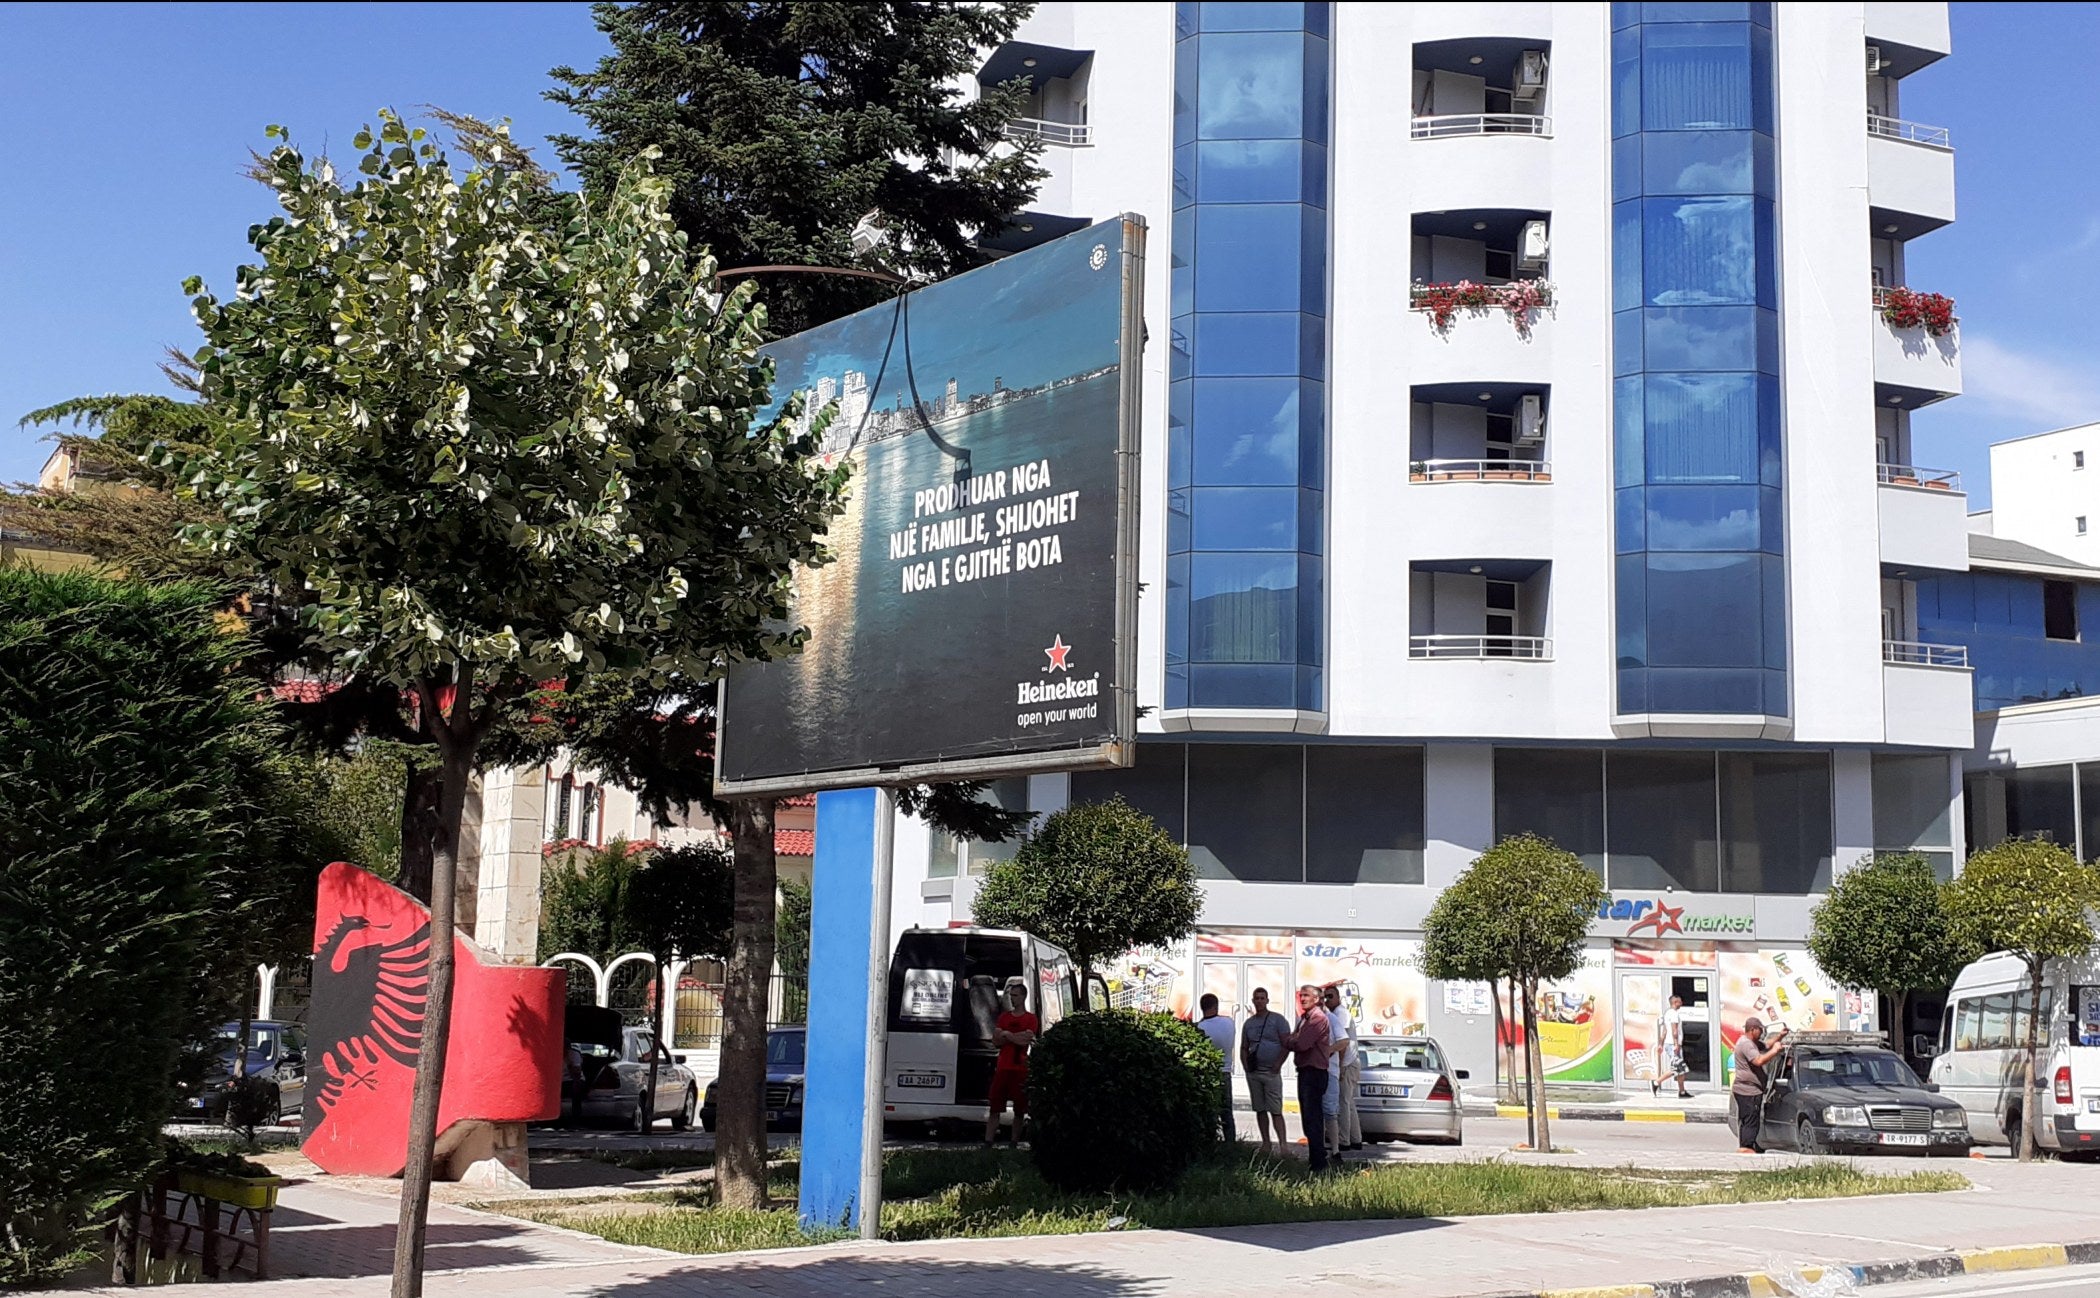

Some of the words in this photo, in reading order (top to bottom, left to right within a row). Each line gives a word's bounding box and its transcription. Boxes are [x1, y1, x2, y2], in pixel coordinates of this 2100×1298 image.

[914, 470, 1006, 518] PRODHUAR
[1012, 459, 1051, 495] NGA
[889, 521, 918, 560] NJË
[921, 512, 990, 553] FAMILJE,
[995, 490, 1080, 537] SHIJOHET
[902, 561, 937, 593] NGA
[941, 557, 950, 586] E
[954, 537, 1012, 583] GJITHË
[1016, 534, 1063, 572] BOTA
[1017, 676, 1099, 705] Heineken
[1017, 711, 1042, 729] open
[1044, 708, 1067, 726] your
[1069, 701, 1097, 720] world
[1575, 898, 1654, 921] tar
[1683, 913, 1754, 934] market
[1302, 943, 1347, 958] star
[1367, 1085, 1376, 1095] AA
